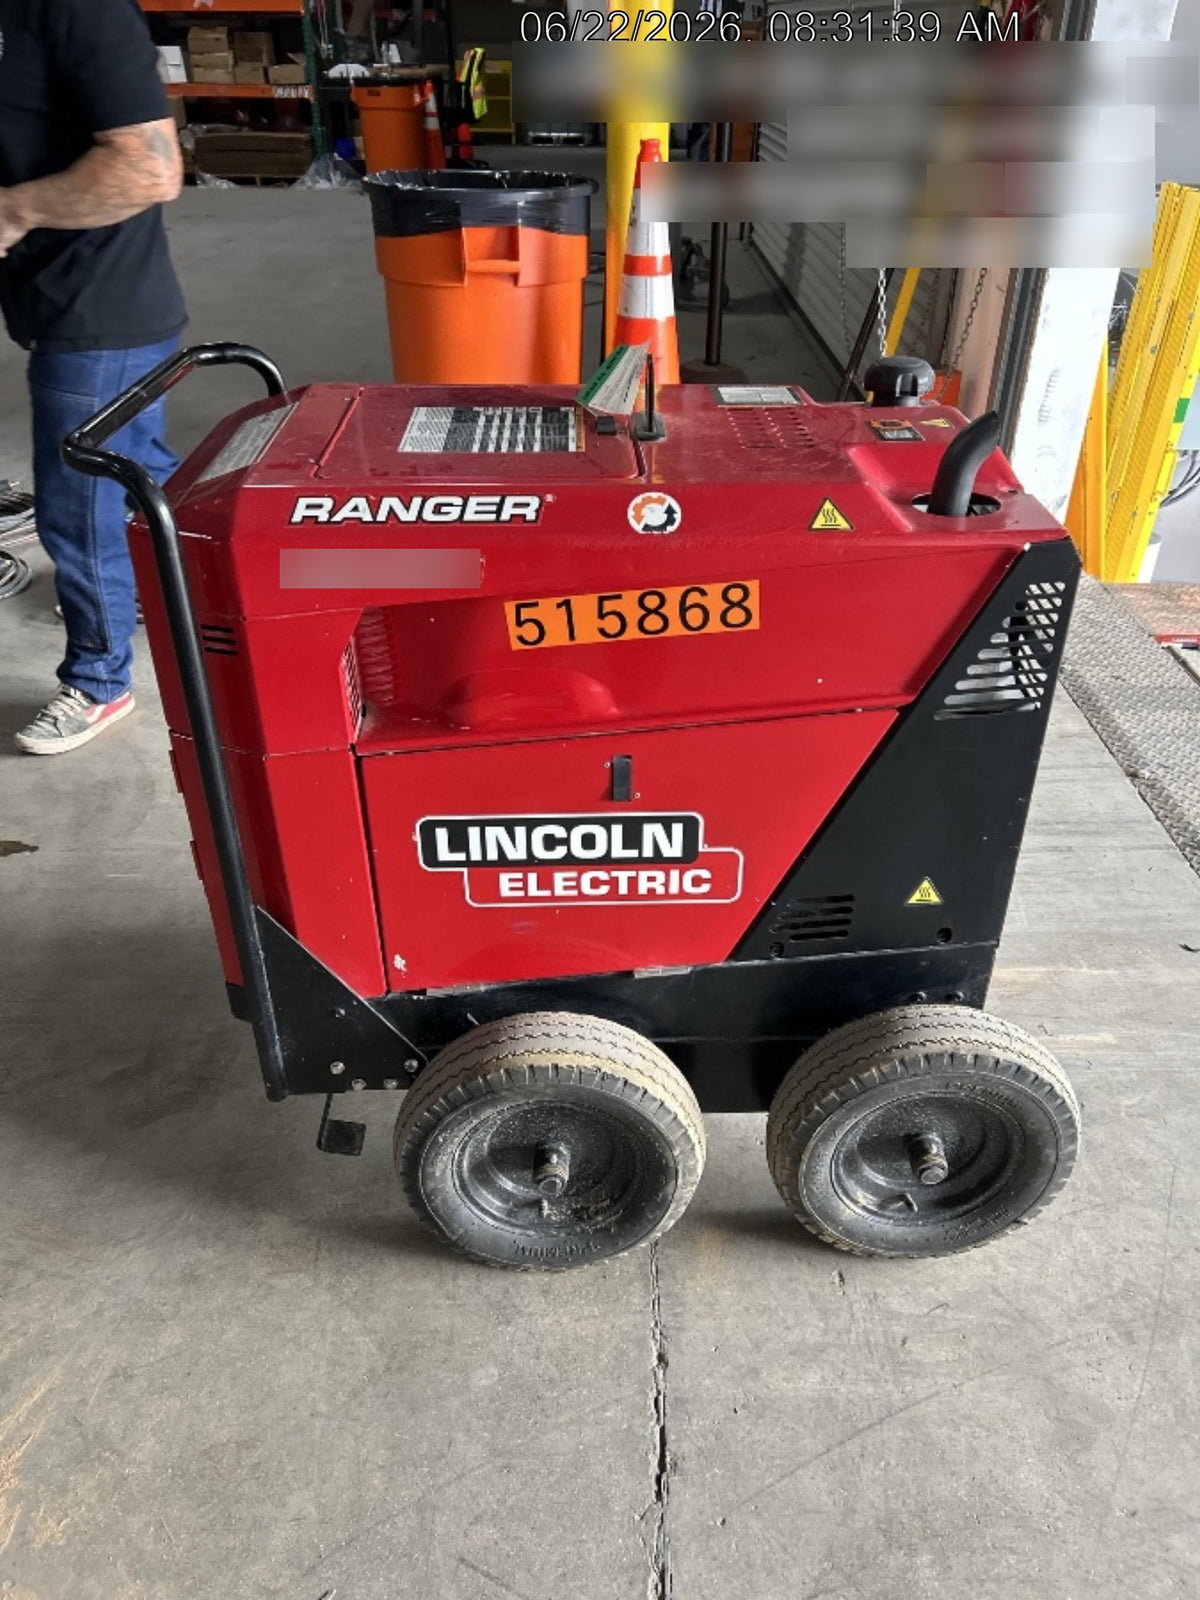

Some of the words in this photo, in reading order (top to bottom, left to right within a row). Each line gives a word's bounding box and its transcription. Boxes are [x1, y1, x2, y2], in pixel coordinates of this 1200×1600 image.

[514, 582, 753, 647] 515868
[434, 822, 684, 862] LINCOLN
[499, 868, 712, 898] ELECTRIC
